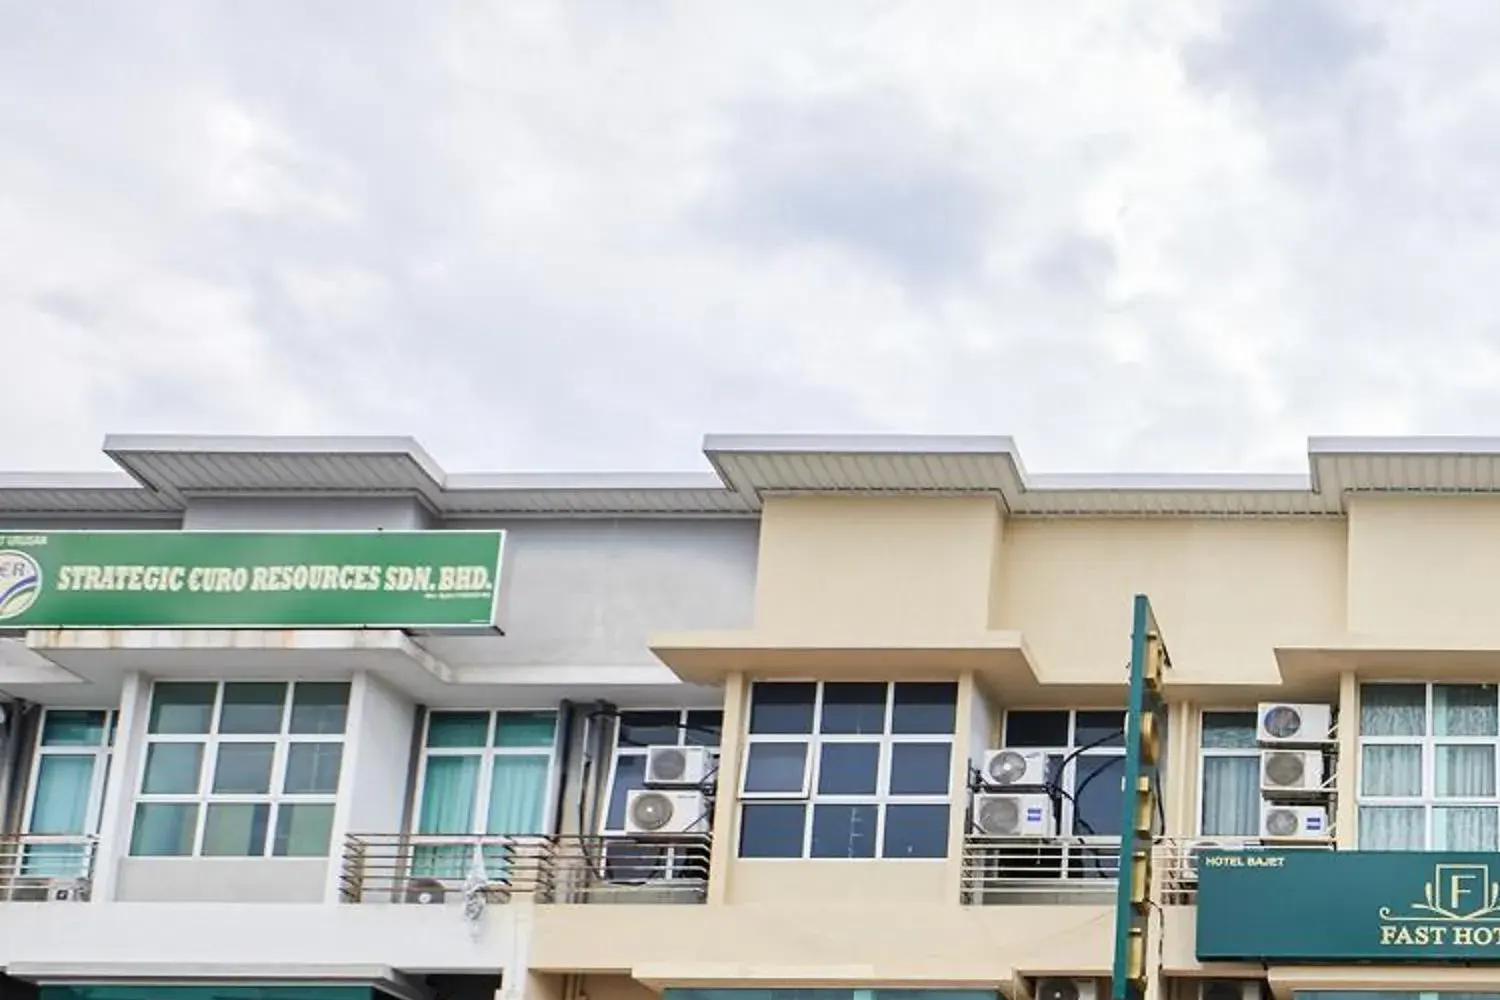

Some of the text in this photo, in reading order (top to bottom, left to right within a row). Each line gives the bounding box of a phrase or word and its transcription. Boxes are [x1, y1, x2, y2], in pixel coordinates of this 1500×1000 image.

[57, 565, 185, 591] STRATEGIC
[250, 565, 381, 591] RESOURCES
[384, 566, 436, 591] SDN.
[438, 566, 492, 591] BHD.
[1205, 856, 1286, 867] HOTEL BAJET
[1451, 874, 1477, 909] F
[1379, 925, 1447, 945] FAST
